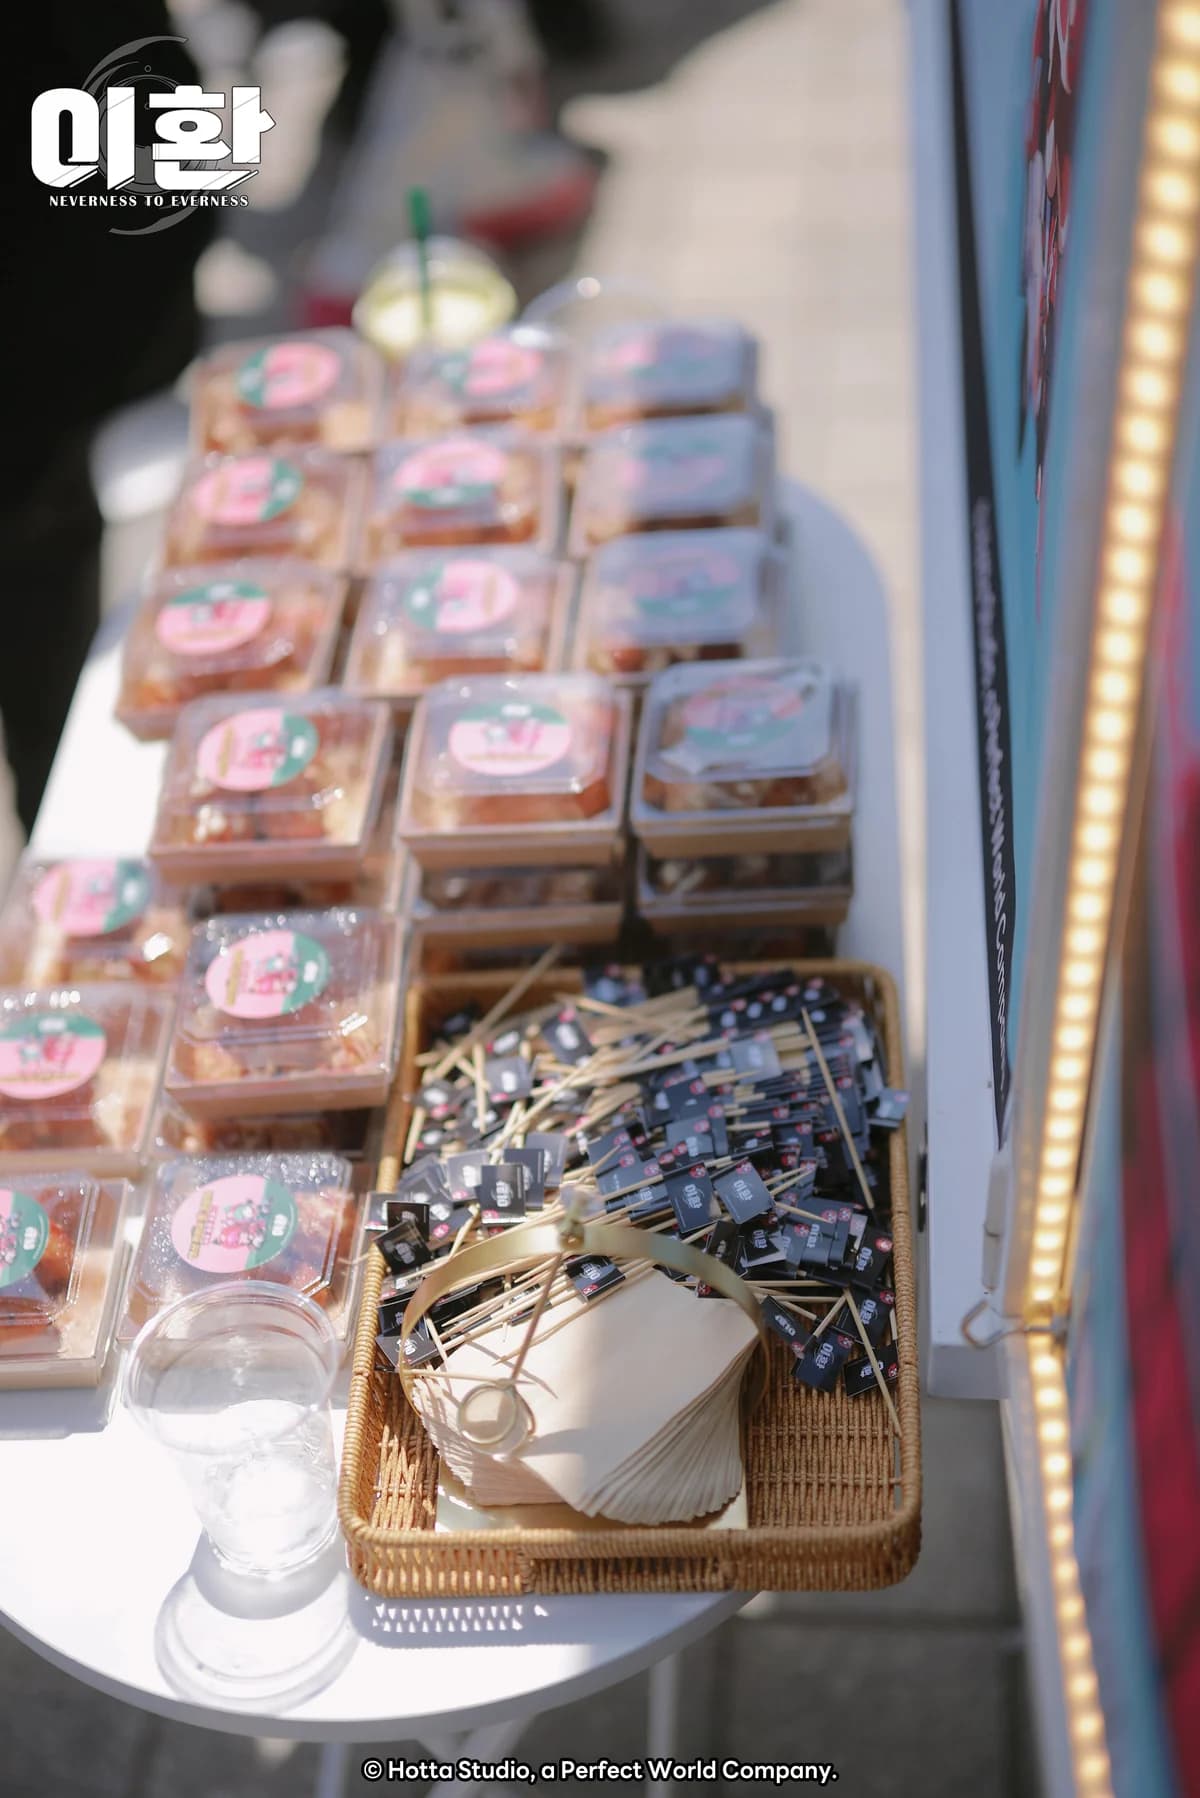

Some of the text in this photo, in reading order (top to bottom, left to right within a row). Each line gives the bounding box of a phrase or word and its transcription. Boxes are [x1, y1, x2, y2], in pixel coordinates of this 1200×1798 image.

[684, 1183, 702, 1208] 이환
[733, 1180, 753, 1201] 이환
[856, 1247, 872, 1271] 이환
[815, 1342, 833, 1369] 이환
